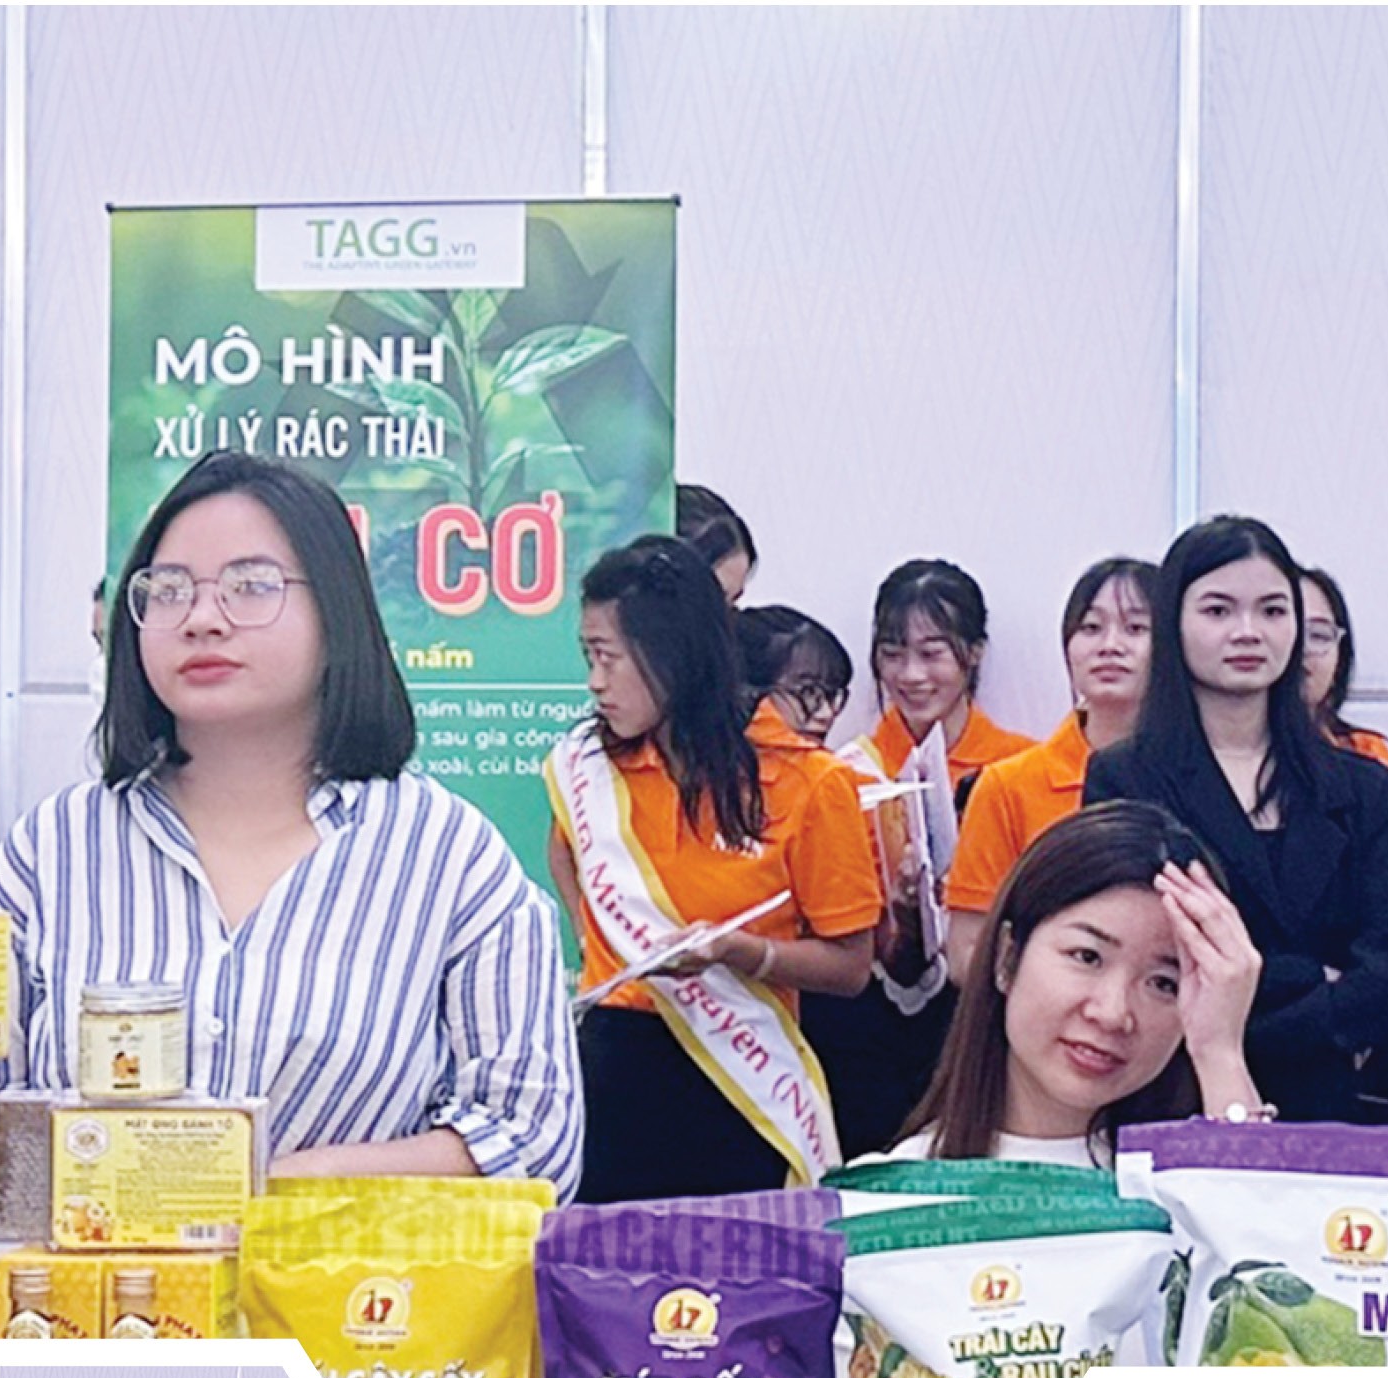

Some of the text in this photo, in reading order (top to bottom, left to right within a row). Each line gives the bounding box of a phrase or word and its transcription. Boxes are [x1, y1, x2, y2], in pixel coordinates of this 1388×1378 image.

[156, 325, 445, 386] MÔ HÌNH
[154, 399, 204, 458] XỬ
[276, 407, 349, 458] RÁC
[362, 407, 445, 458] THẢI
[417, 489, 564, 619] CƠ
[405, 641, 475, 669] nấm
[467, 699, 506, 718] làm
[431, 730, 507, 750] sau gia
[586, 861, 769, 1072] Minh guyên
[949, 1320, 1065, 1363] TRÁI CÂY
